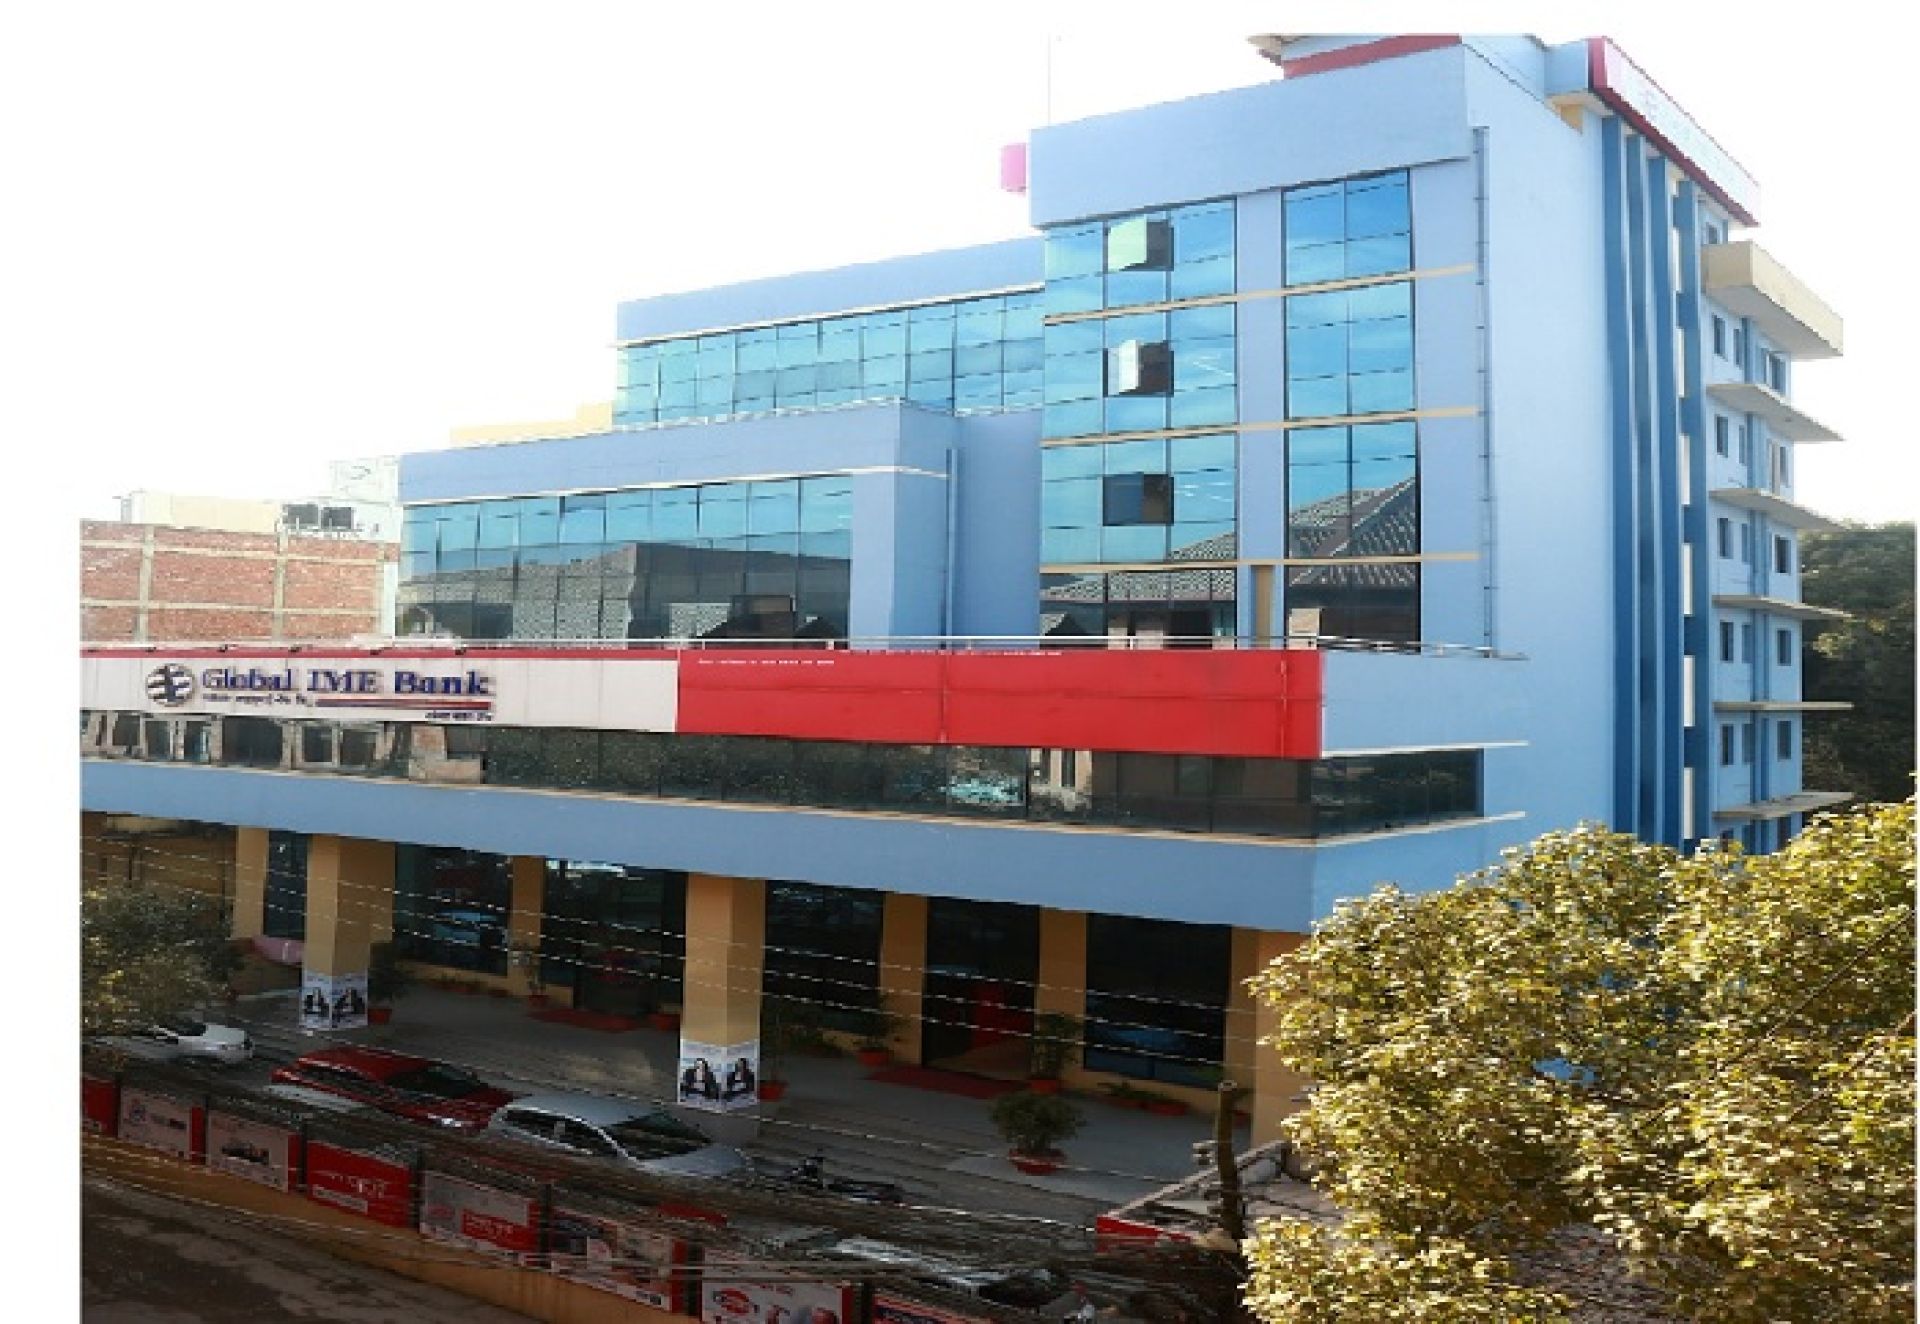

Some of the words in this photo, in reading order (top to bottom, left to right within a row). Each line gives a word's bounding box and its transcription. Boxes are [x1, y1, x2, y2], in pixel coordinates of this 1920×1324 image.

[202, 667, 299, 691] Global
[306, 669, 380, 693] IME
[394, 670, 492, 696] Bank
